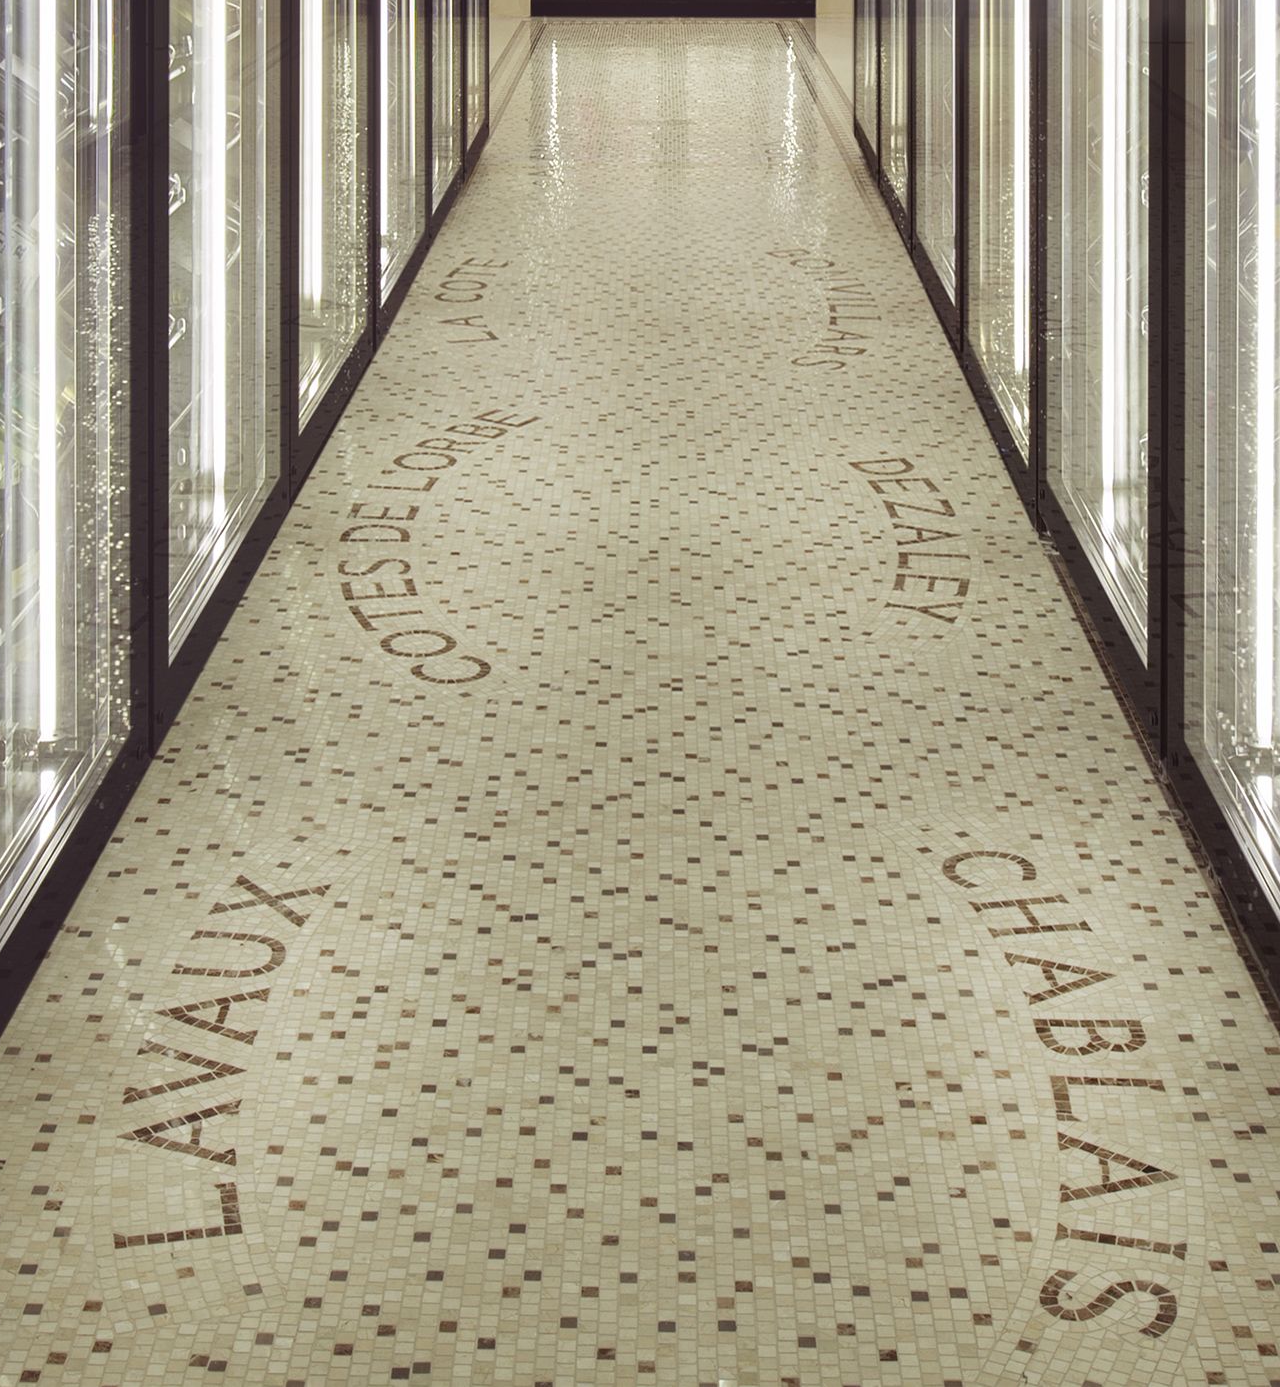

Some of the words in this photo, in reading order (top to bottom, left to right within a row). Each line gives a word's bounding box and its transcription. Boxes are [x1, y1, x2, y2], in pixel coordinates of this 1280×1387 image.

[437, 314, 500, 345] LA
[765, 248, 882, 371] BONVILLARS
[367, 409, 543, 492] L'ORBE
[339, 502, 420, 543] DE
[847, 457, 972, 625] DEZALEY
[113, 874, 332, 1249] LAVAUX
[941, 850, 1188, 1340] CHABLAIS
